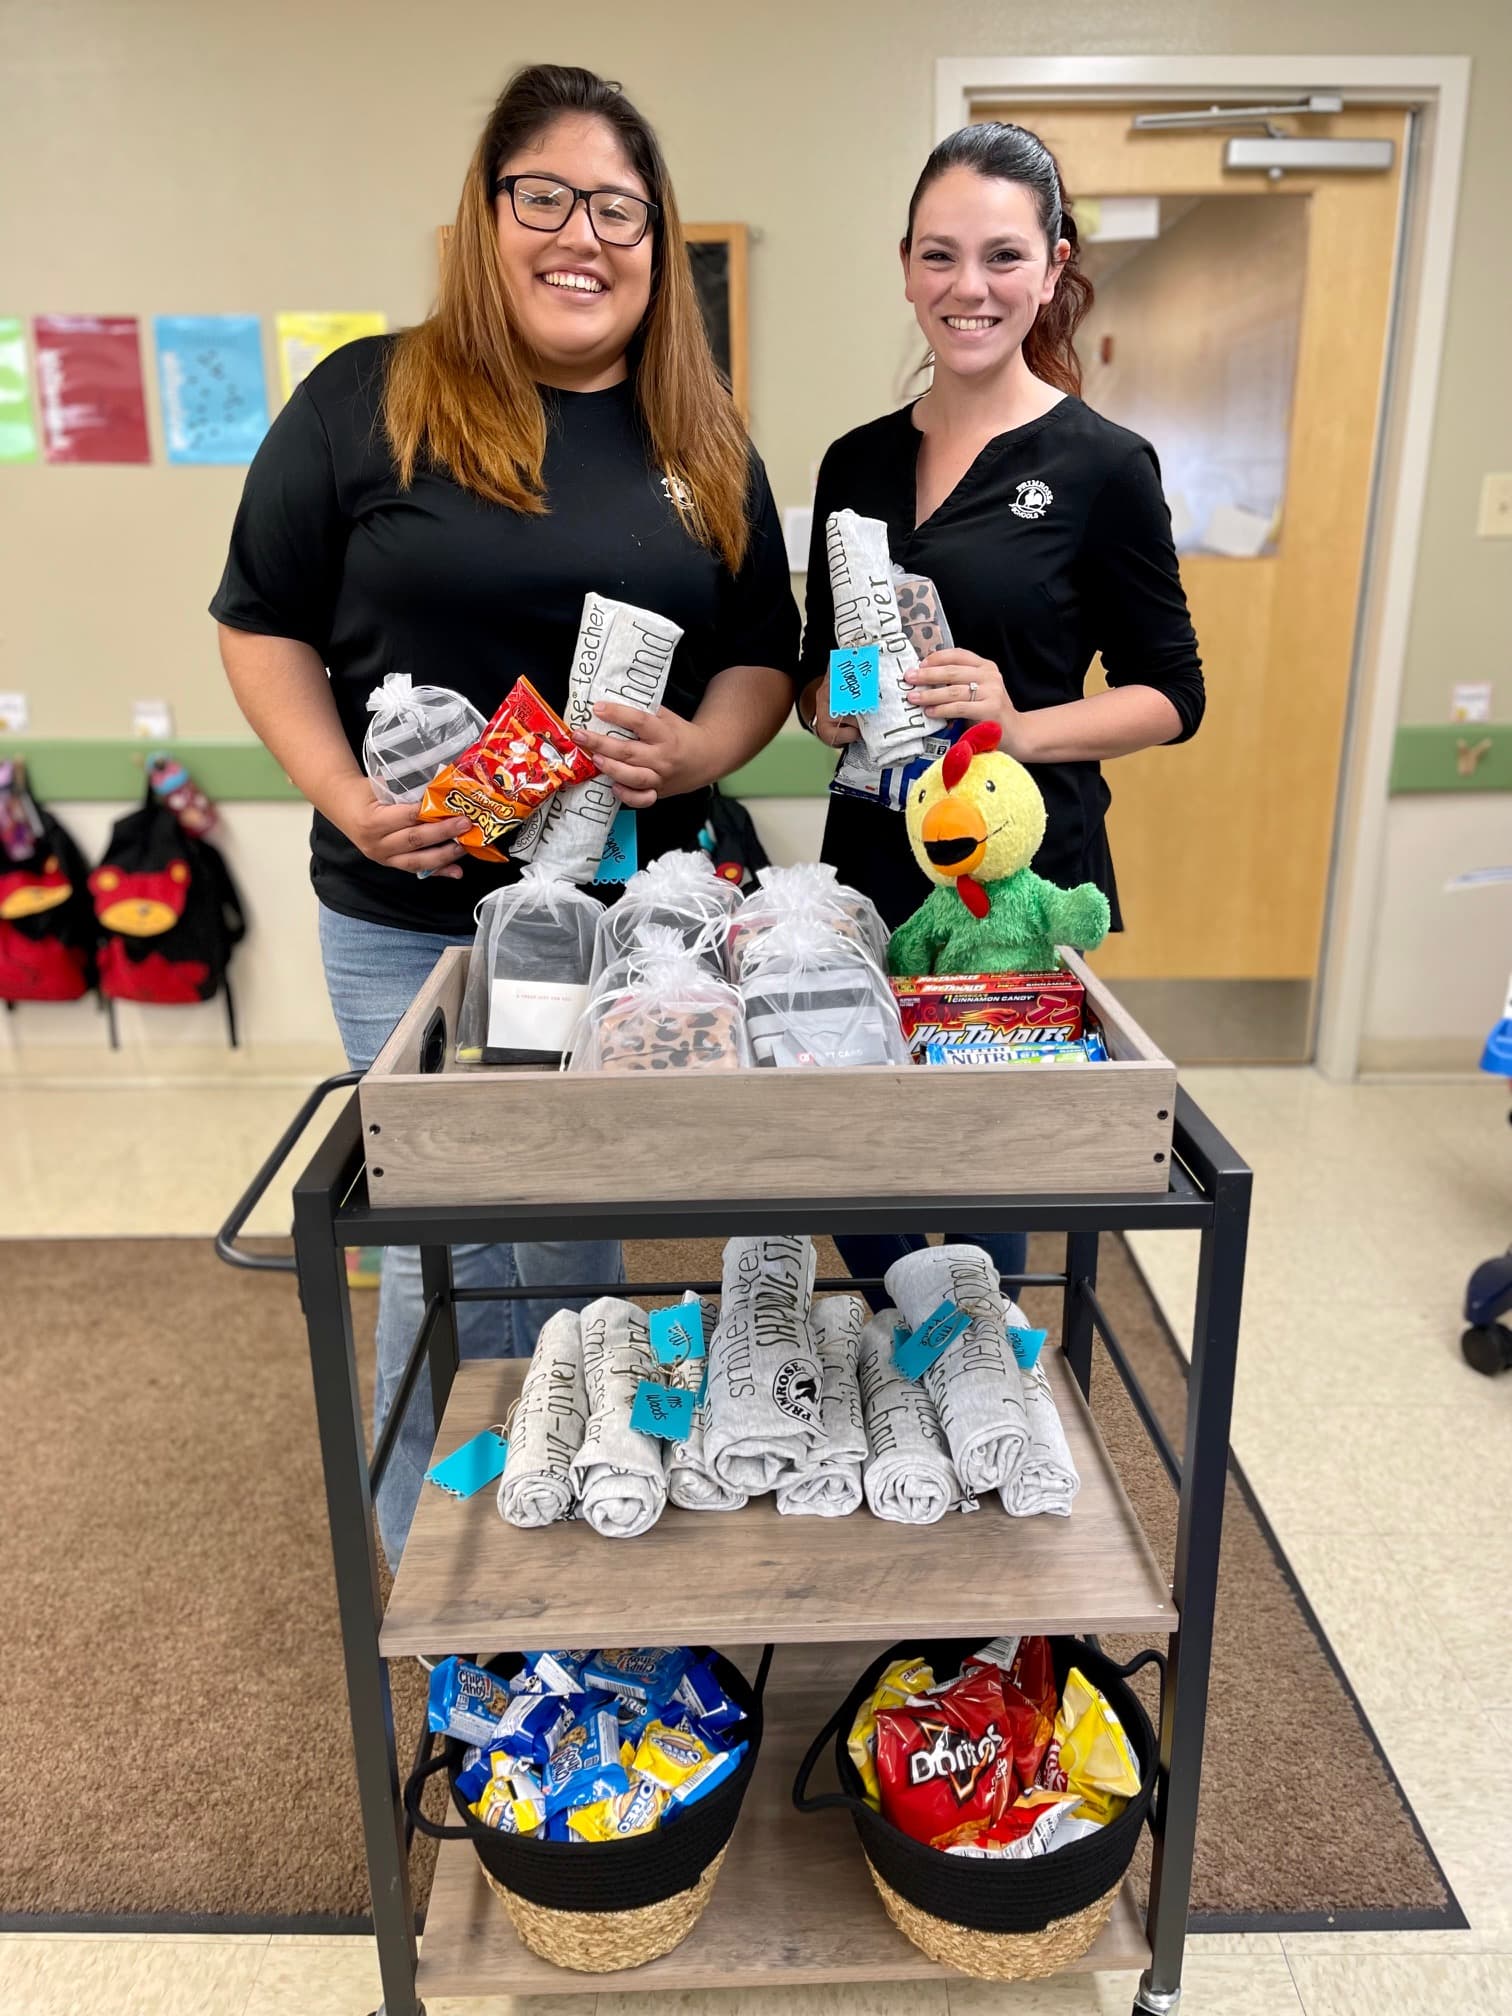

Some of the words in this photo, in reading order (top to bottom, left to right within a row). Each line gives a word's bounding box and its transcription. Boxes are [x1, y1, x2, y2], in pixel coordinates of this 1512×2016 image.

[577, 603, 607, 687] teacher
[605, 620, 678, 709] hand
[1001, 994, 1032, 1002] CANDY
[911, 1723, 1003, 1785] Doritos
[618, 1778, 657, 1831] OREO
